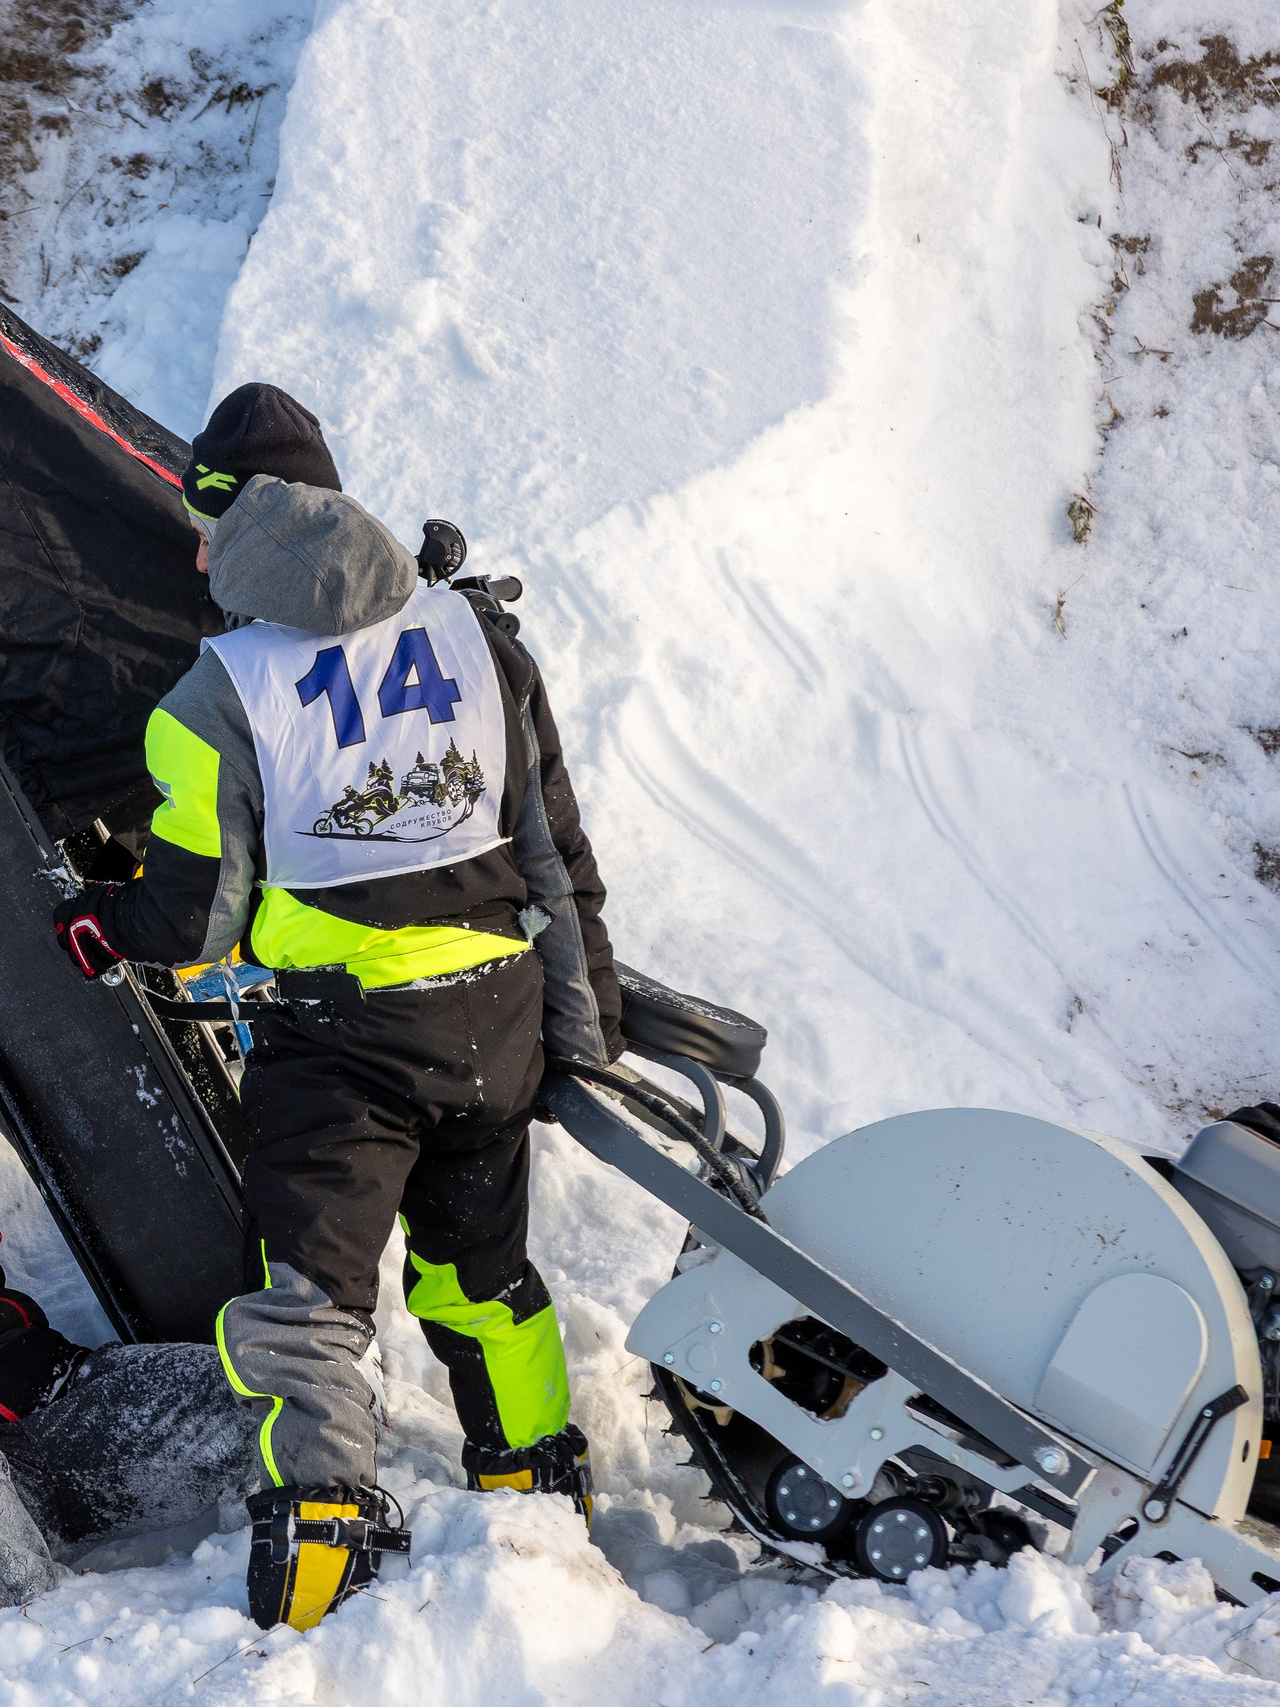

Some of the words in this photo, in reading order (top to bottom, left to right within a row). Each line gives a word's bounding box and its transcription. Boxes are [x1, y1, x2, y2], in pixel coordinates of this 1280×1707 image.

[295, 627, 462, 749] 14
[390, 808, 452, 830] СОДРУЖЕСТВО
[420, 815, 452, 829] КЛУБОВ
